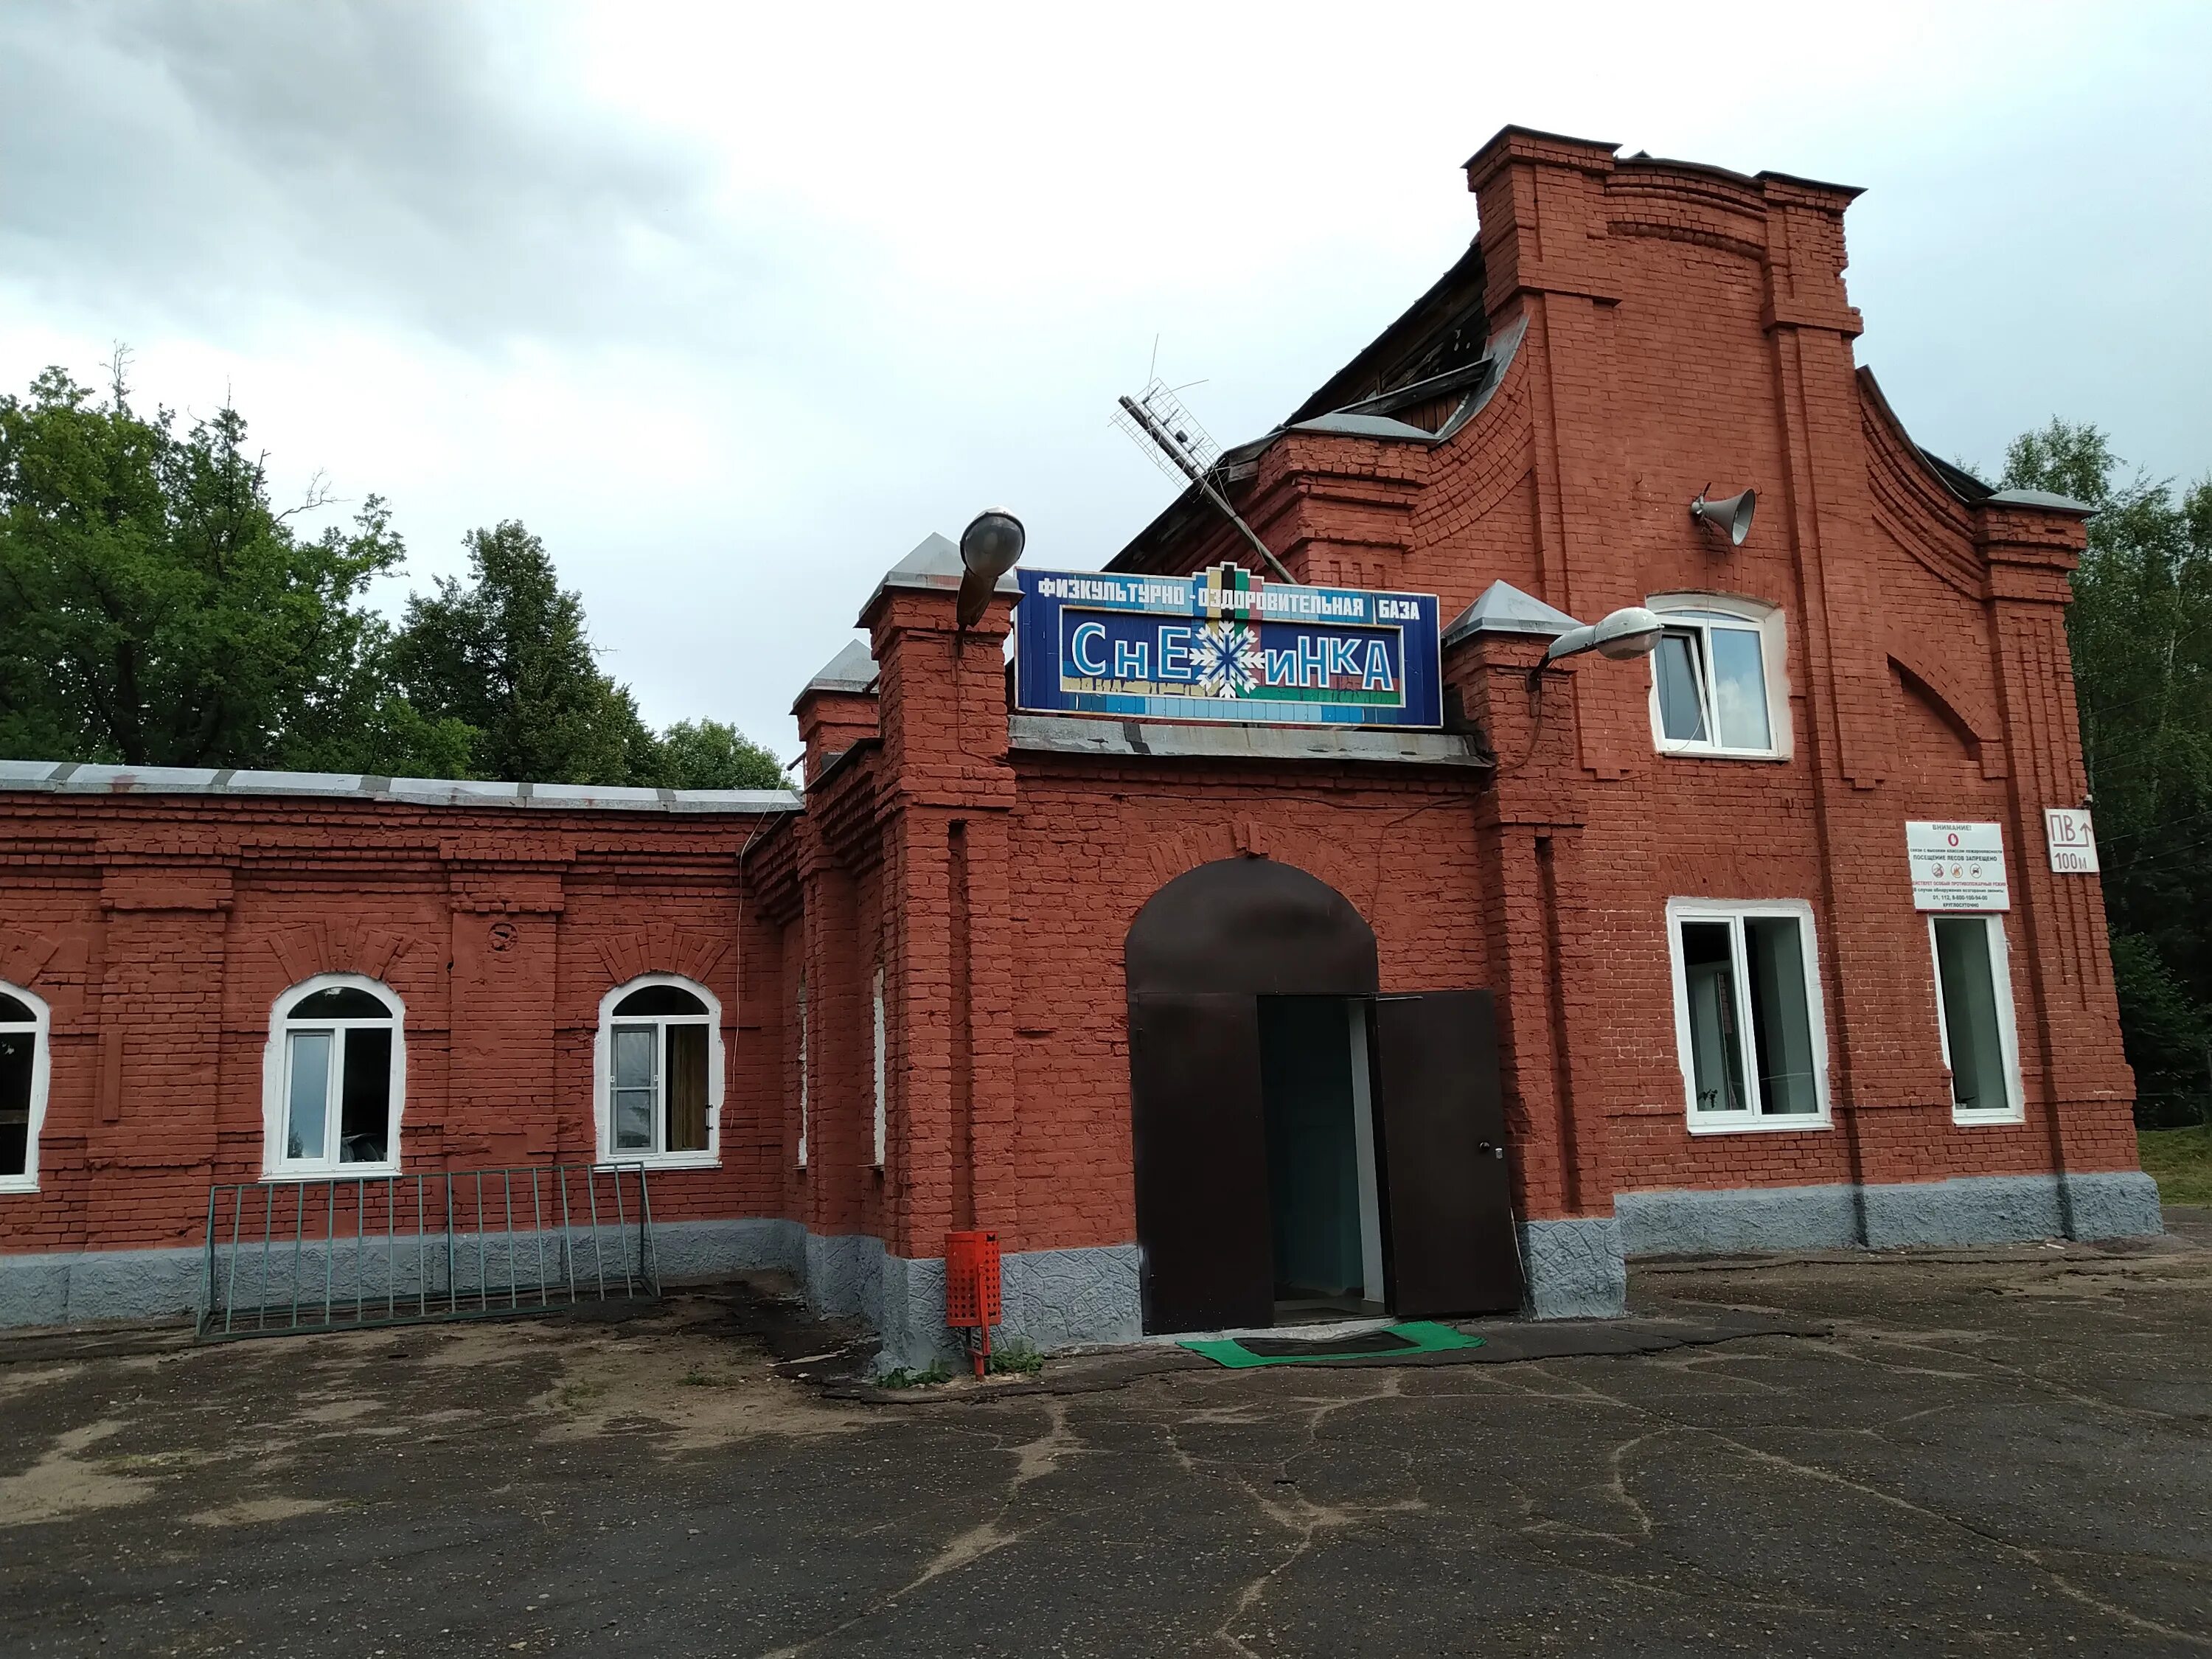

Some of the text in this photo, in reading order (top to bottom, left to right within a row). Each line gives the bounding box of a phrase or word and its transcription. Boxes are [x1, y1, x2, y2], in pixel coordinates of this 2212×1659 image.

[1379, 599, 1420, 620] БАЗА
[1932, 824, 1972, 832] ВНИМАНИЕ!
[2049, 814, 2076, 842] ПВ
